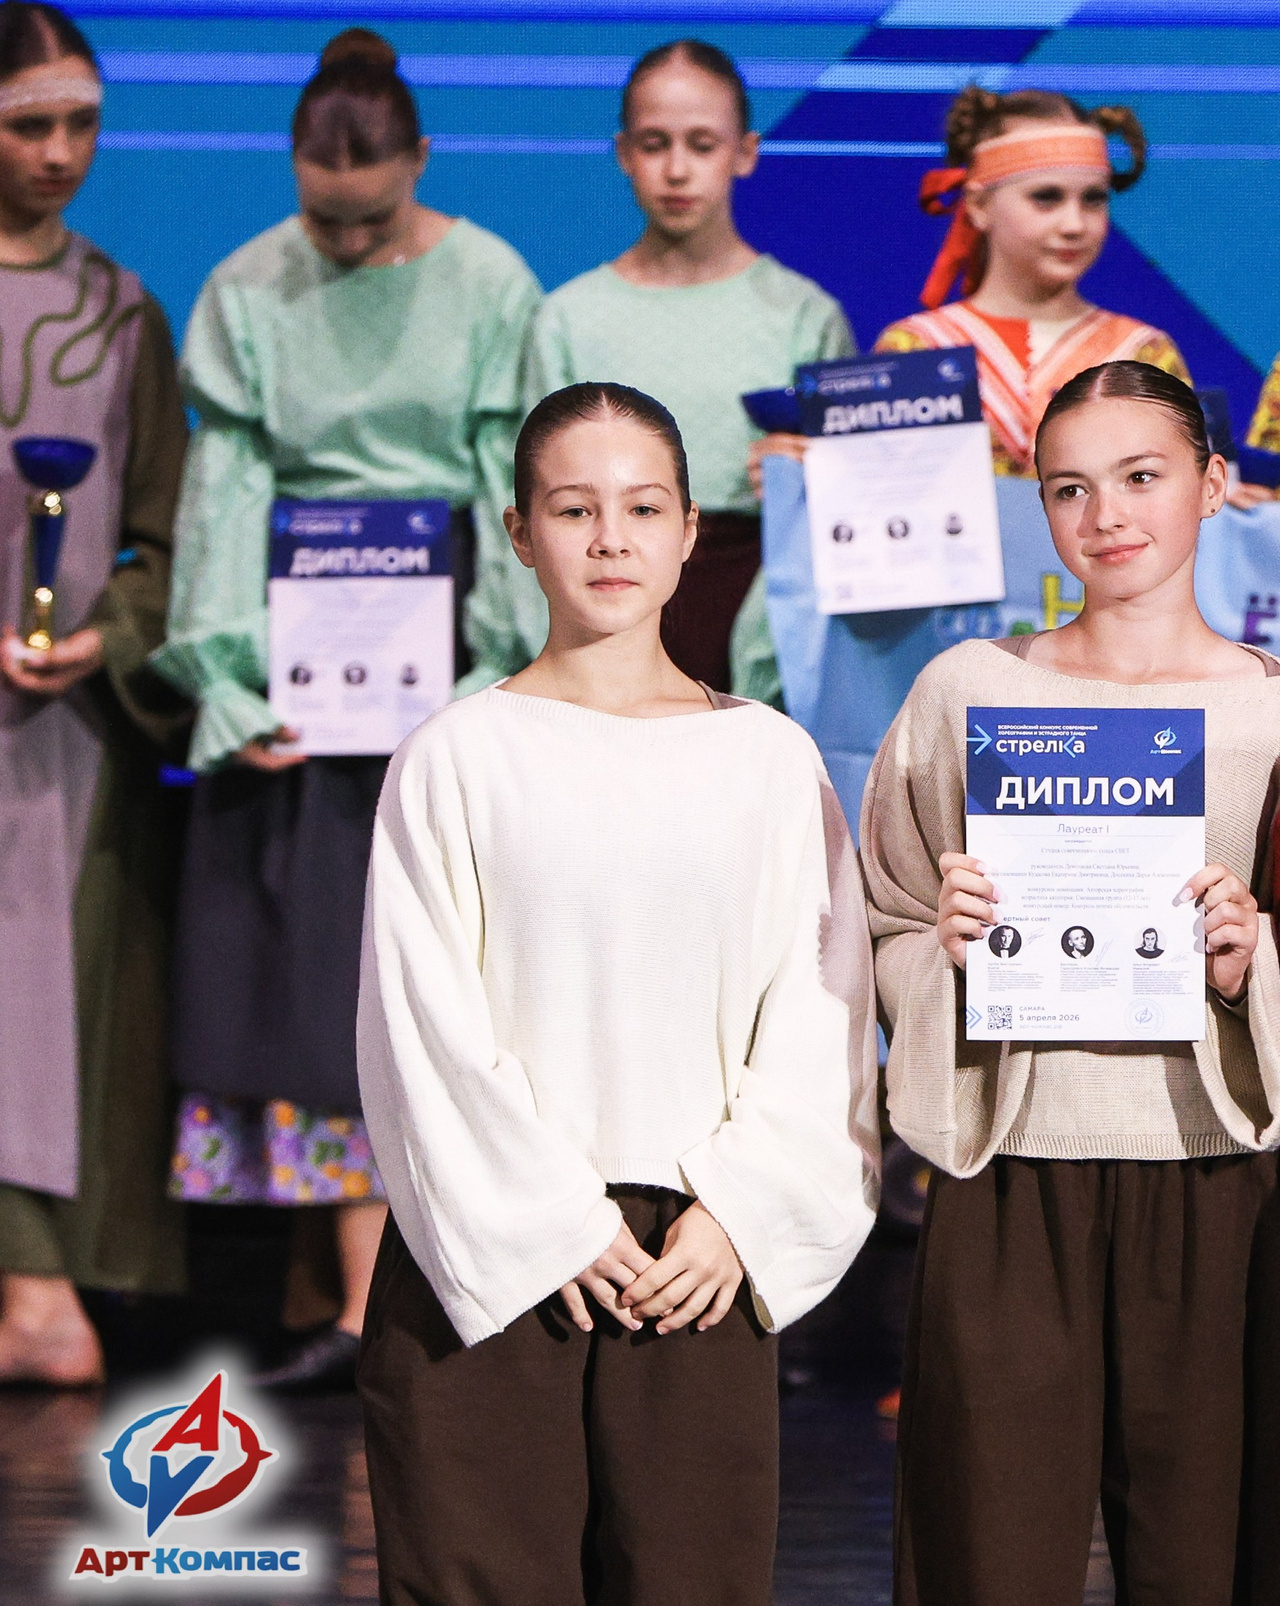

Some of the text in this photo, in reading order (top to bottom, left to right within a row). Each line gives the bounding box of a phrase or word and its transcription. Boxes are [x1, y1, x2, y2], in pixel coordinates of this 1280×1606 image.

[822, 394, 964, 435] ДИПЛОМ
[289, 547, 430, 577] ДИПЛОМ
[996, 737, 1085, 757] стрелка
[995, 776, 1174, 810] ДИПЛОМ
[1057, 823, 1103, 835] Лауреат
